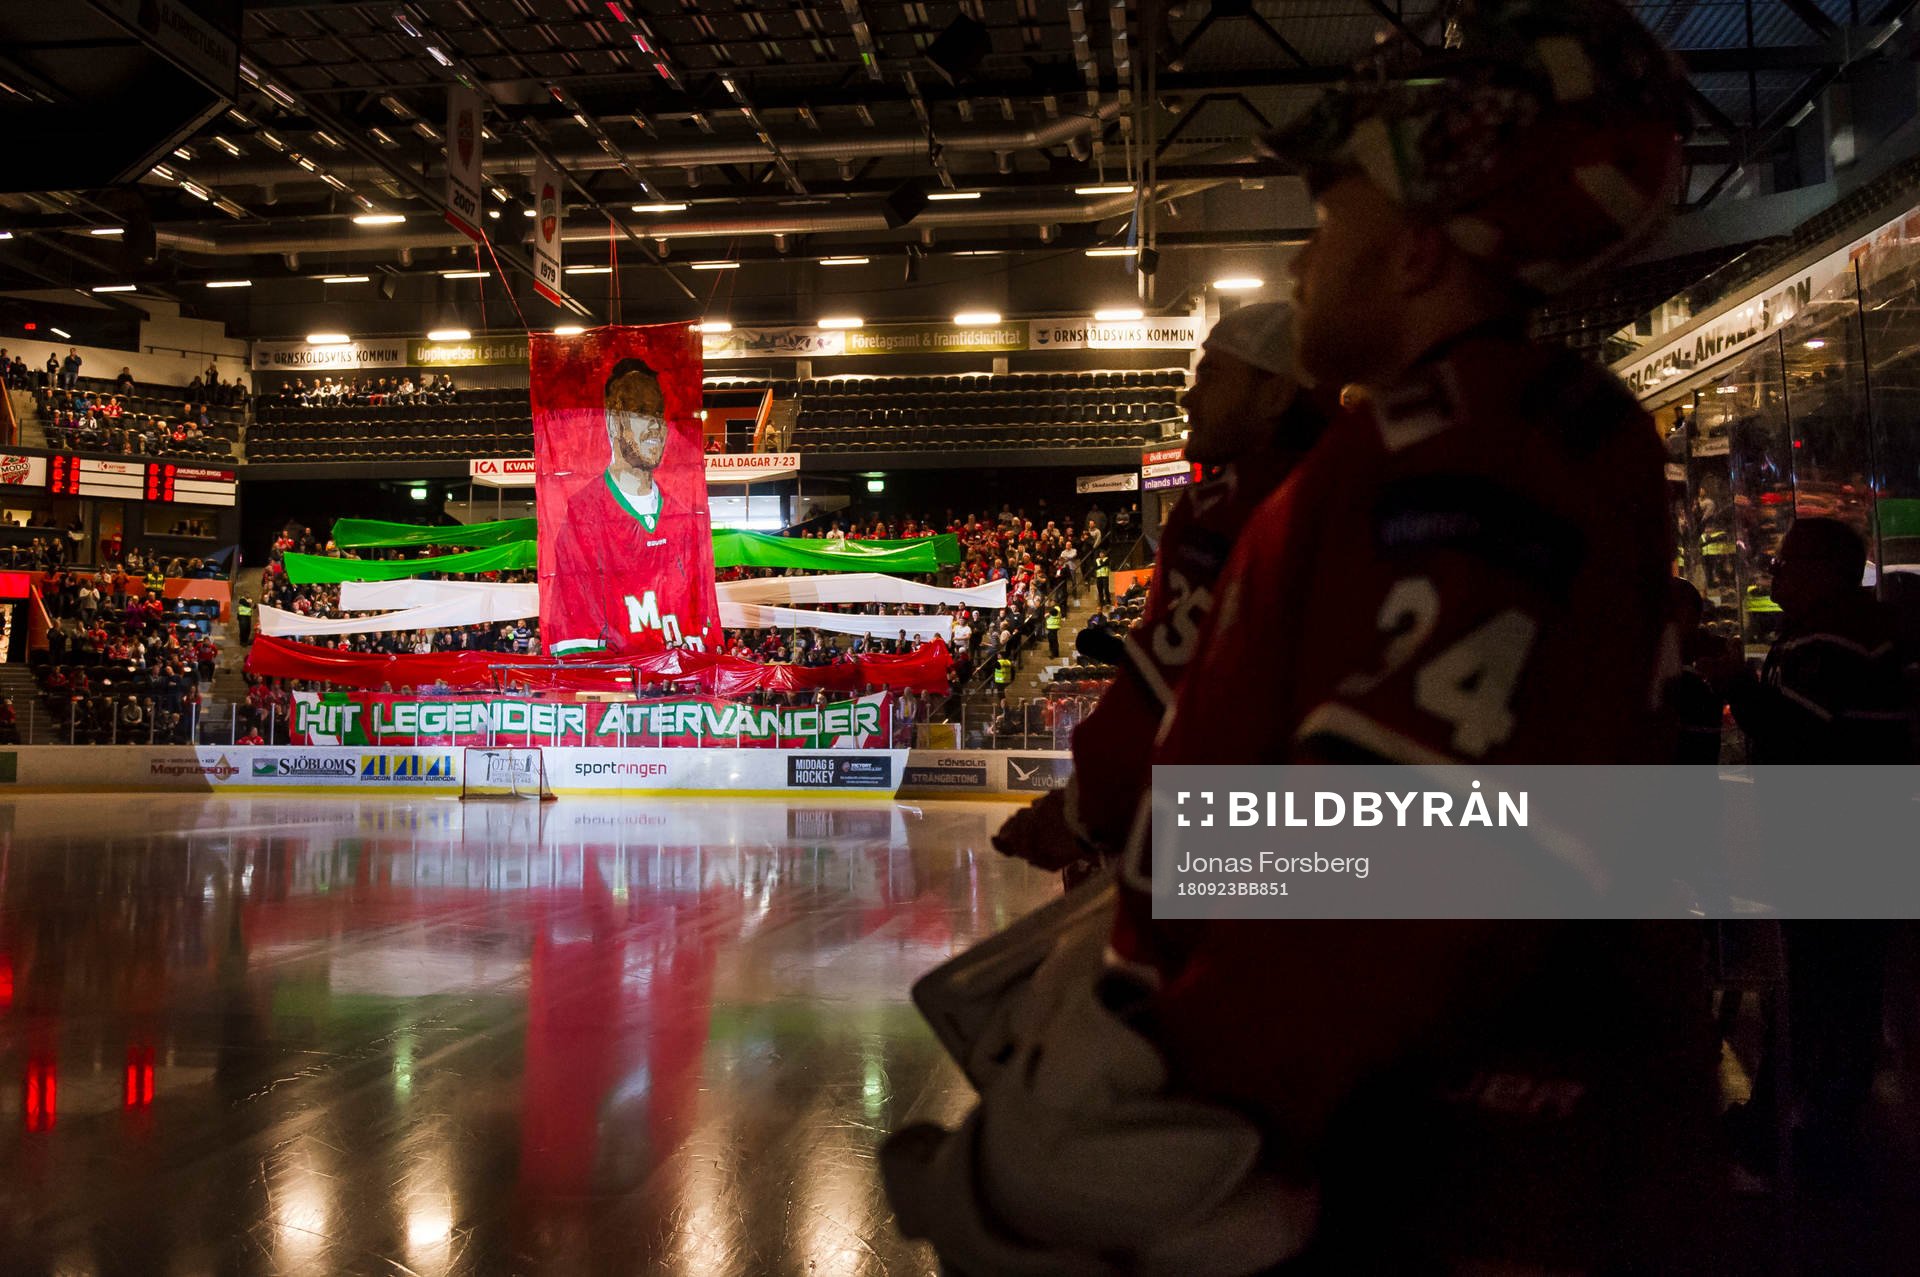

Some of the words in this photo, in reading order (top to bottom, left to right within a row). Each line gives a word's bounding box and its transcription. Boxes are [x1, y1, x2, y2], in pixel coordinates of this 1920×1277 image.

[454, 190, 476, 218] 2007
[540, 261, 556, 283] 1979
[852, 332, 919, 350] Företagsamt
[934, 330, 1021, 346] framtidsinriktat
[1054, 327, 1142, 342] ÖRNSKÖLDSVIKS
[1147, 329, 1194, 342] KOMMUN
[356, 349, 398, 362] KOMMUN
[1, 463, 28, 472] MODO
[475, 461, 498, 473] ICA
[711, 457, 734, 467] ALLA
[737, 457, 770, 467] DAGAR
[299, 703, 361, 732] HIT
[373, 702, 583, 733] LEGENDER
[599, 703, 879, 736] ÅTERVÄNDER
[151, 764, 240, 776] Magnussons
[279, 755, 356, 775] SJÖBLOMS
[575, 761, 667, 778] sportringen
[795, 759, 827, 770] MIDDAG
[828, 759, 834, 769] &
[795, 770, 835, 784] HOCKEY
